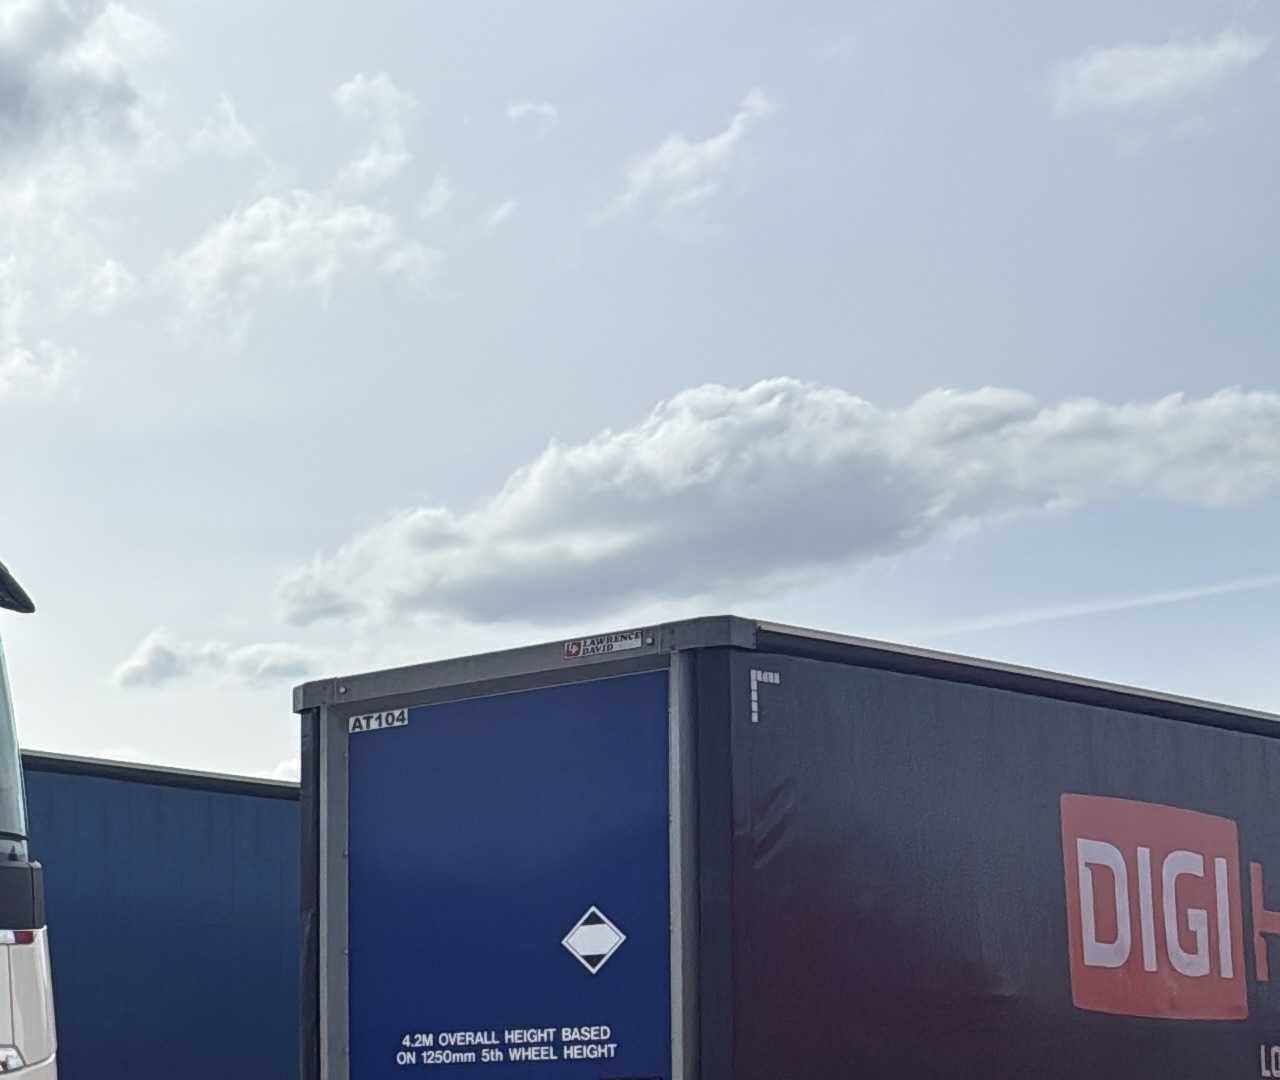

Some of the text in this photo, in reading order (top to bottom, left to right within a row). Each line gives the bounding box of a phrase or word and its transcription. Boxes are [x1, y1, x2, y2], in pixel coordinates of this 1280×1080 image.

[582, 644, 614, 655] DAVID
[583, 631, 640, 647] LAWRENCE
[351, 709, 407, 731] AT104
[1077, 838, 1234, 979] DIGI
[402, 1025, 611, 1048] 4.2M OVERALL HEIGHT BASED
[396, 1043, 618, 1065] ON 1250mm 5th WHEEL HEIGHT
